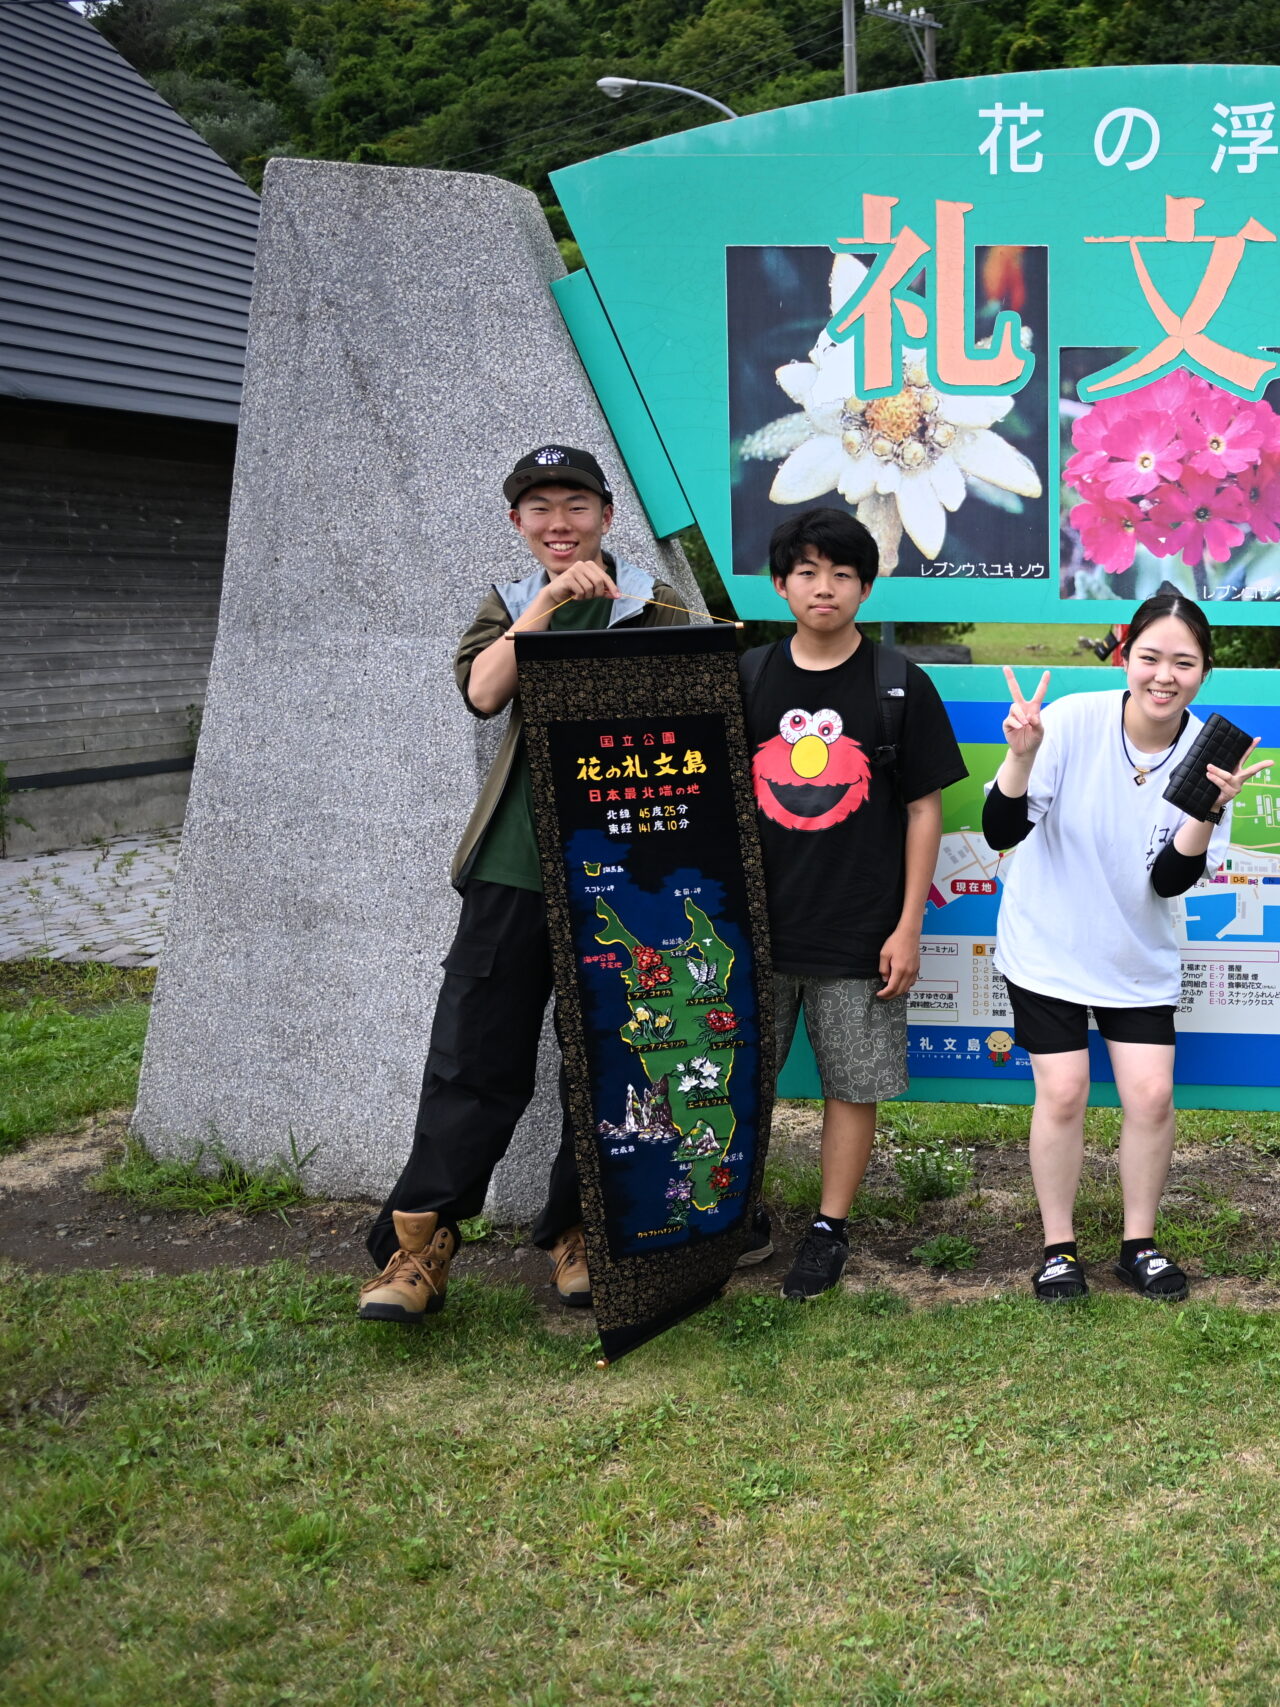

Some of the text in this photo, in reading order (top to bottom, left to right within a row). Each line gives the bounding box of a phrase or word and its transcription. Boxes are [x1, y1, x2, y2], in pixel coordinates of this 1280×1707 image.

[600, 731, 675, 748] 国立公園
[576, 749, 707, 781] 花の礼文島
[588, 782, 701, 803] 日本最北端の地
[955, 881, 992, 893] 現在地
[919, 945, 956, 954] ターミナル
[919, 1036, 980, 1051] 礼文島
[1044, 1263, 1068, 1276] NIKE
[1149, 1258, 1167, 1268] NIKE
